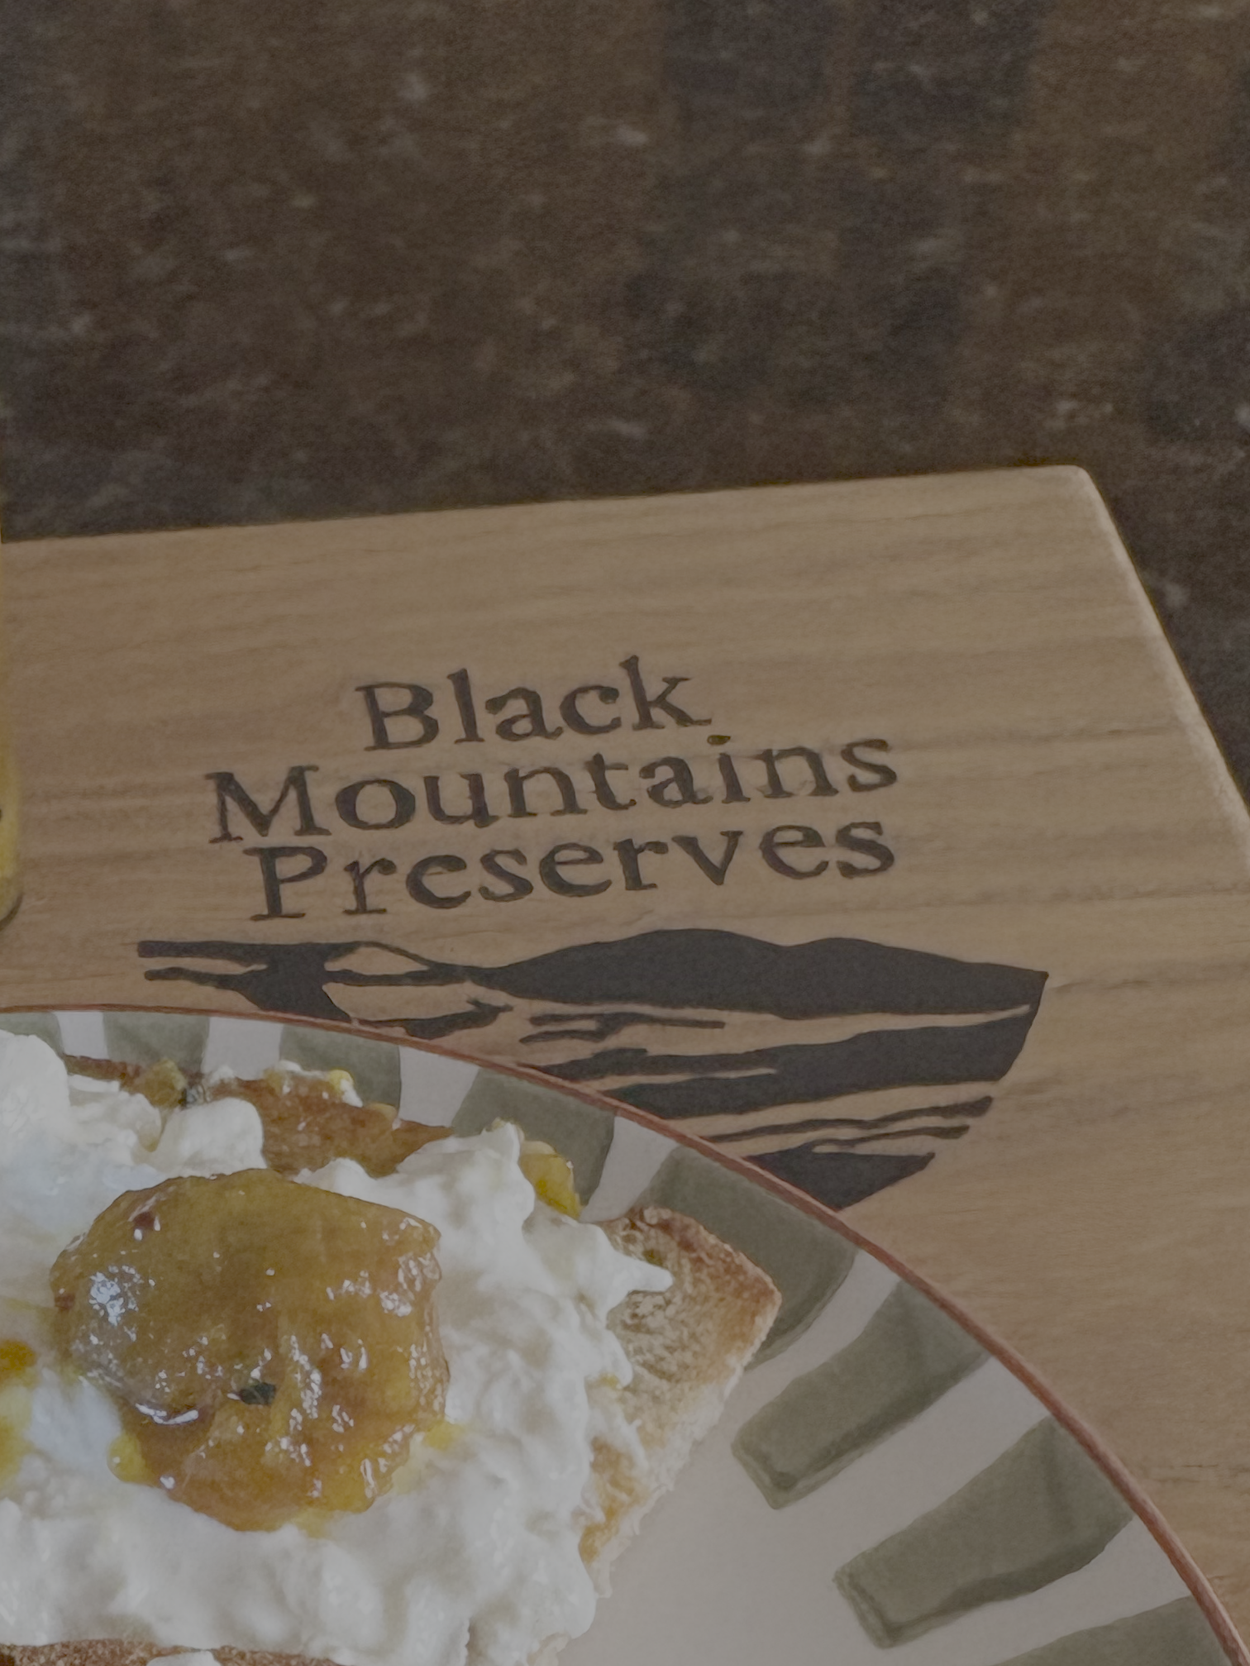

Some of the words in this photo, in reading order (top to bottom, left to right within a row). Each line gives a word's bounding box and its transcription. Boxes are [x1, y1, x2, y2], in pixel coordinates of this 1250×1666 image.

[353, 655, 712, 752] Black
[203, 734, 898, 844] Mountains
[241, 820, 896, 922] Preserves
